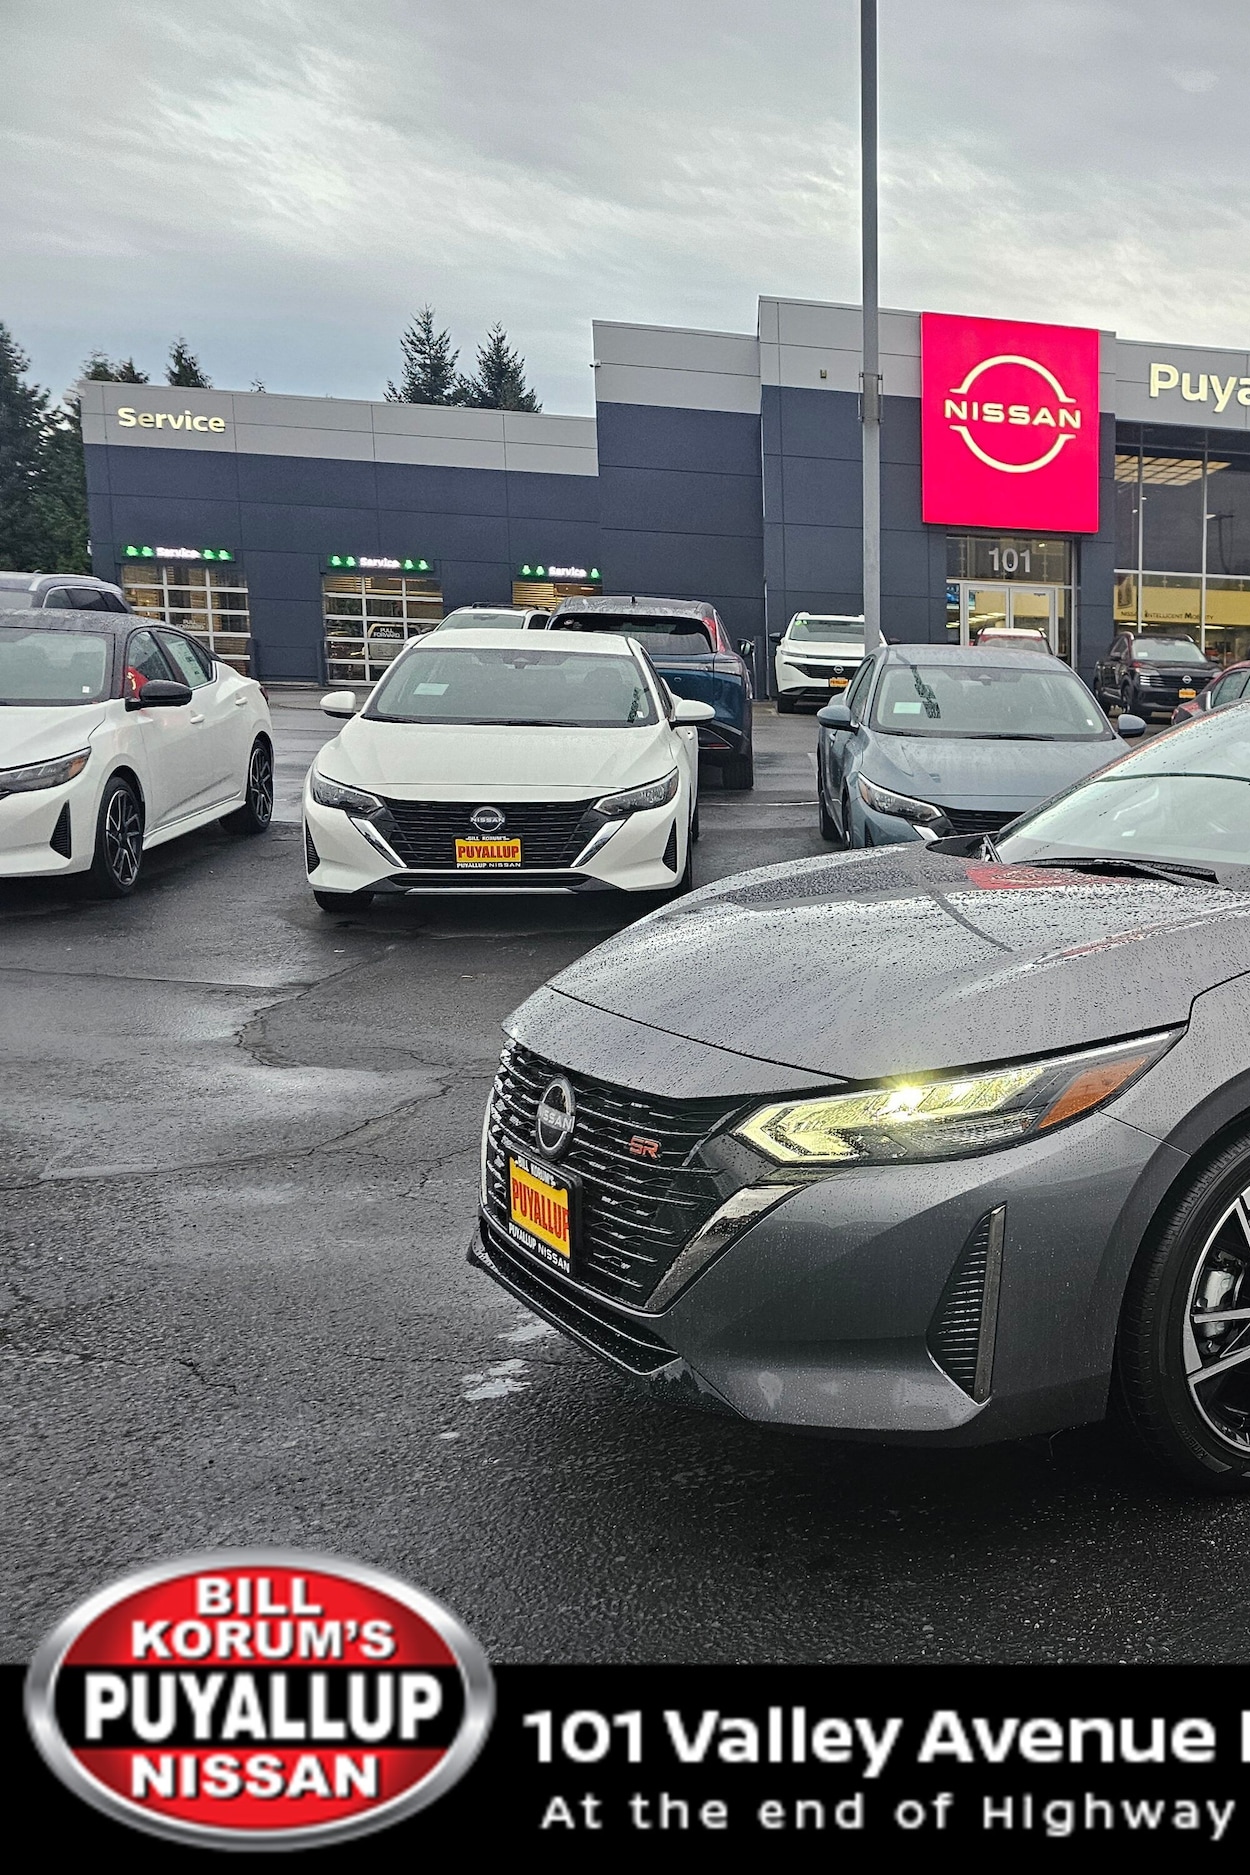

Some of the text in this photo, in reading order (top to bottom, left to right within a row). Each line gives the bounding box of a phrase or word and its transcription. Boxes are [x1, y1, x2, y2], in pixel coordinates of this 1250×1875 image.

[117, 406, 226, 433] Service
[943, 398, 1082, 430] NISSAN
[359, 557, 401, 569] Service
[548, 566, 588, 578] Service
[988, 547, 1031, 573] 101
[457, 845, 519, 858] PUYALLUP
[629, 1135, 662, 1160] SR
[511, 1176, 570, 1242] PUYALLUP
[508, 1221, 571, 1274] PUYALLUP NISSAN
